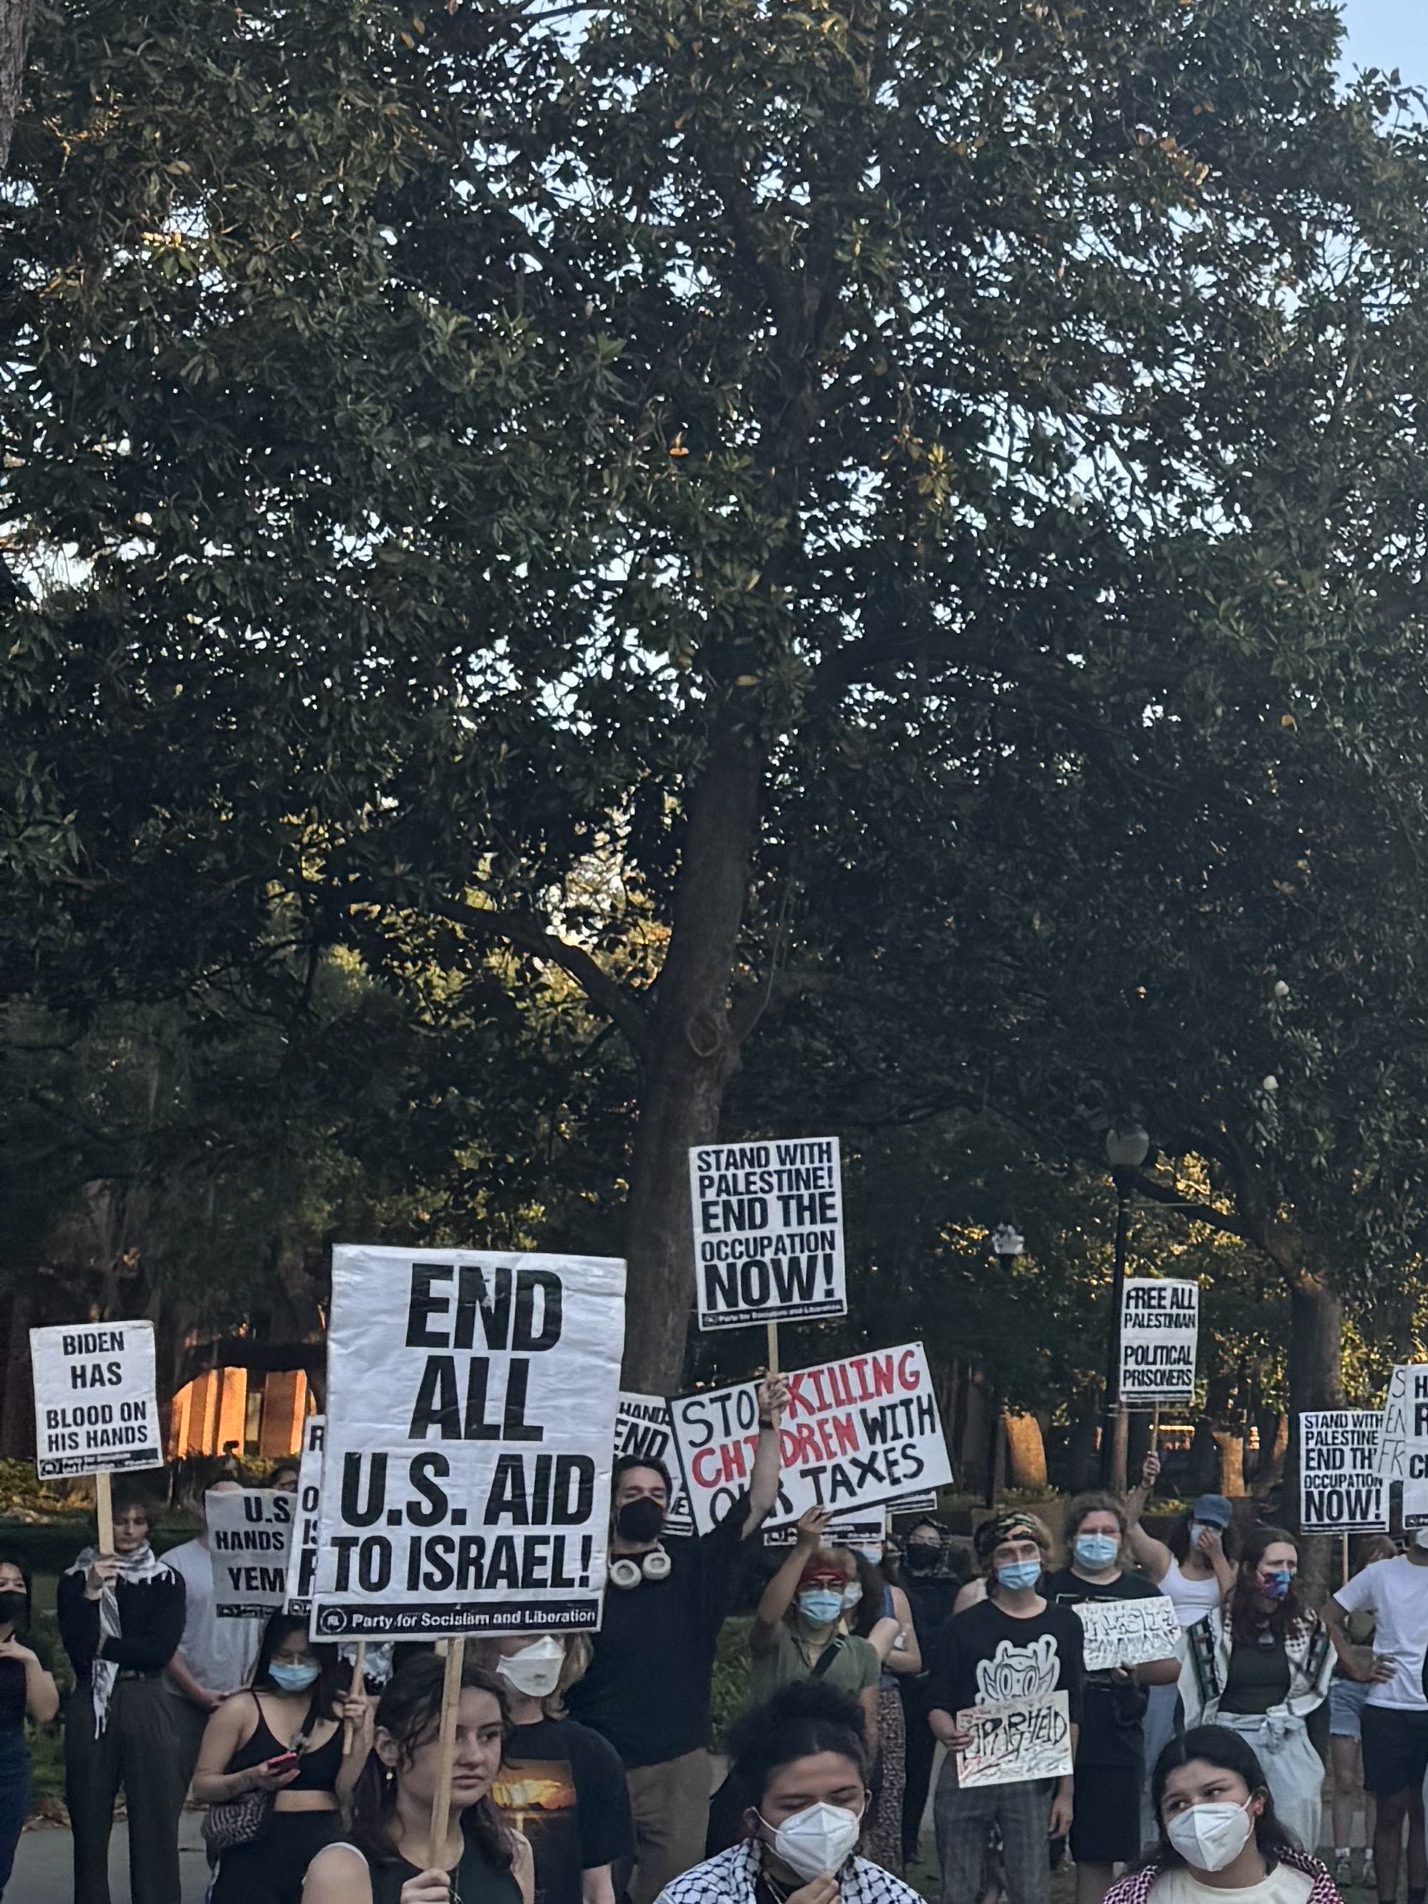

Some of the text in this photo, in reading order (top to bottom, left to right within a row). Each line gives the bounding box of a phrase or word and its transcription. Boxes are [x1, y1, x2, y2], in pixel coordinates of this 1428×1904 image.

[697, 1142, 832, 1172] STAND WITH
[699, 1166, 833, 1198] PALESTINE!
[701, 1191, 838, 1234] END THE
[701, 1230, 835, 1262] OCCUPATION
[704, 1253, 834, 1311] NOW!
[405, 1263, 563, 1352] END
[1126, 1287, 1195, 1309] FREE ALL
[1124, 1313, 1195, 1328] PALESTINIAN
[63, 1331, 124, 1355] BIDEN
[1124, 1345, 1193, 1366] POLITICAL
[71, 1362, 122, 1389] HAS
[1124, 1369, 1192, 1387] PRISONERS
[408, 1355, 544, 1441] ALL
[682, 1350, 920, 1448] STO KILLING
[46, 1401, 146, 1429] BLOOD ON
[1305, 1413, 1383, 1429] STAND WITH
[48, 1426, 147, 1452] HIS HANDS
[692, 1393, 936, 1489] CHIDREN WITH
[1305, 1448, 1377, 1471] END TH
[800, 1444, 924, 1506] TAXES
[1304, 1474, 1383, 1489] OCCUPATION
[341, 1452, 467, 1527] U.S.
[483, 1454, 595, 1526] AID
[1305, 1489, 1381, 1522] NOW!
[215, 1531, 284, 1551] HANDS
[330, 1536, 392, 1592] TO
[407, 1535, 592, 1591] ISRAEL!
[227, 1568, 288, 1592] YEM
[352, 1608, 595, 1630] Party for Socialism and Liberation
